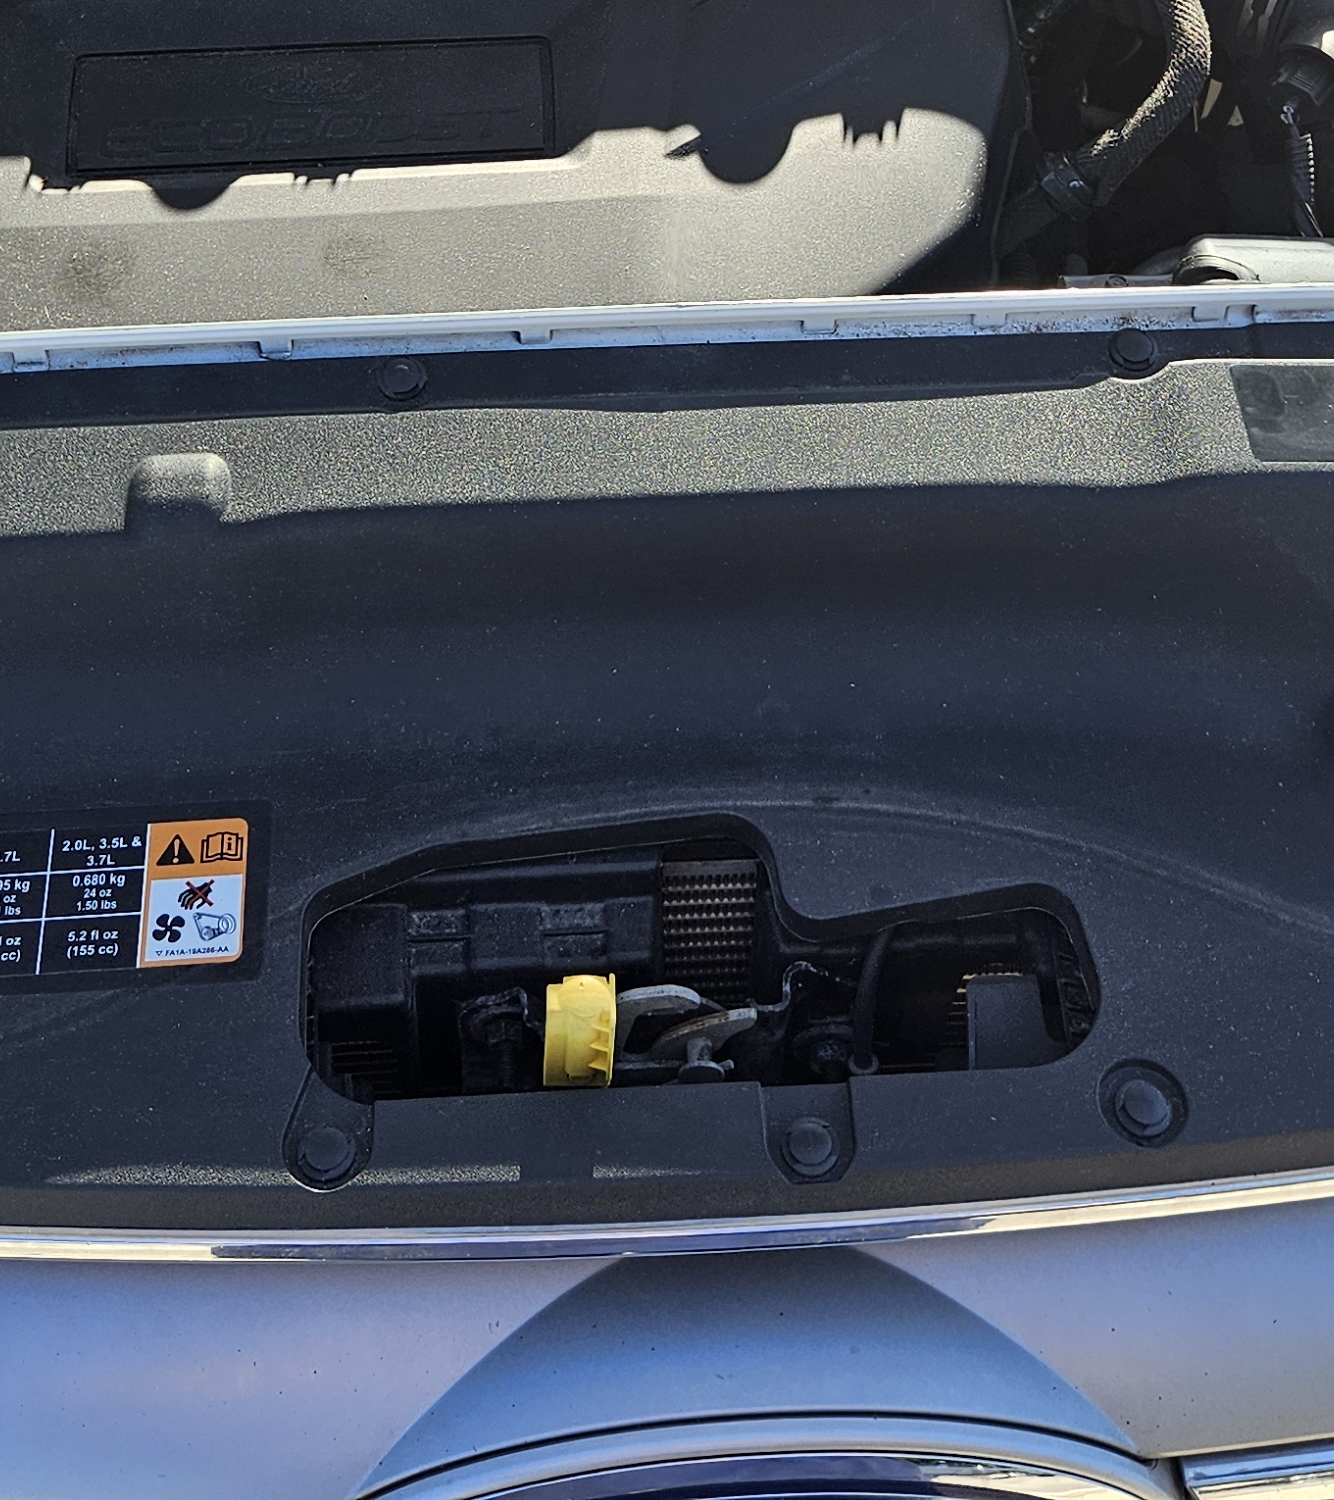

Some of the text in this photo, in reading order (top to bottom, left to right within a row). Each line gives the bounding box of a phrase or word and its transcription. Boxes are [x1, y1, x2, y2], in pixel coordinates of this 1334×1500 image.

[62, 836, 143, 852] 2.0L, 3.5L &
[86, 854, 116, 867] 3.7L
[14, 879, 31, 893] kg
[72, 872, 126, 888] 0.680 kg
[3, 894, 17, 904] oz
[83, 888, 112, 899] 24 oz
[4, 906, 21, 916] lbs
[76, 899, 117, 912] 1.50 lbs
[5, 937, 22, 946] oz
[67, 929, 119, 942] 5.2 fl oz
[0, 949, 21, 963] cc)
[67, 943, 119, 960] (155 cc)
